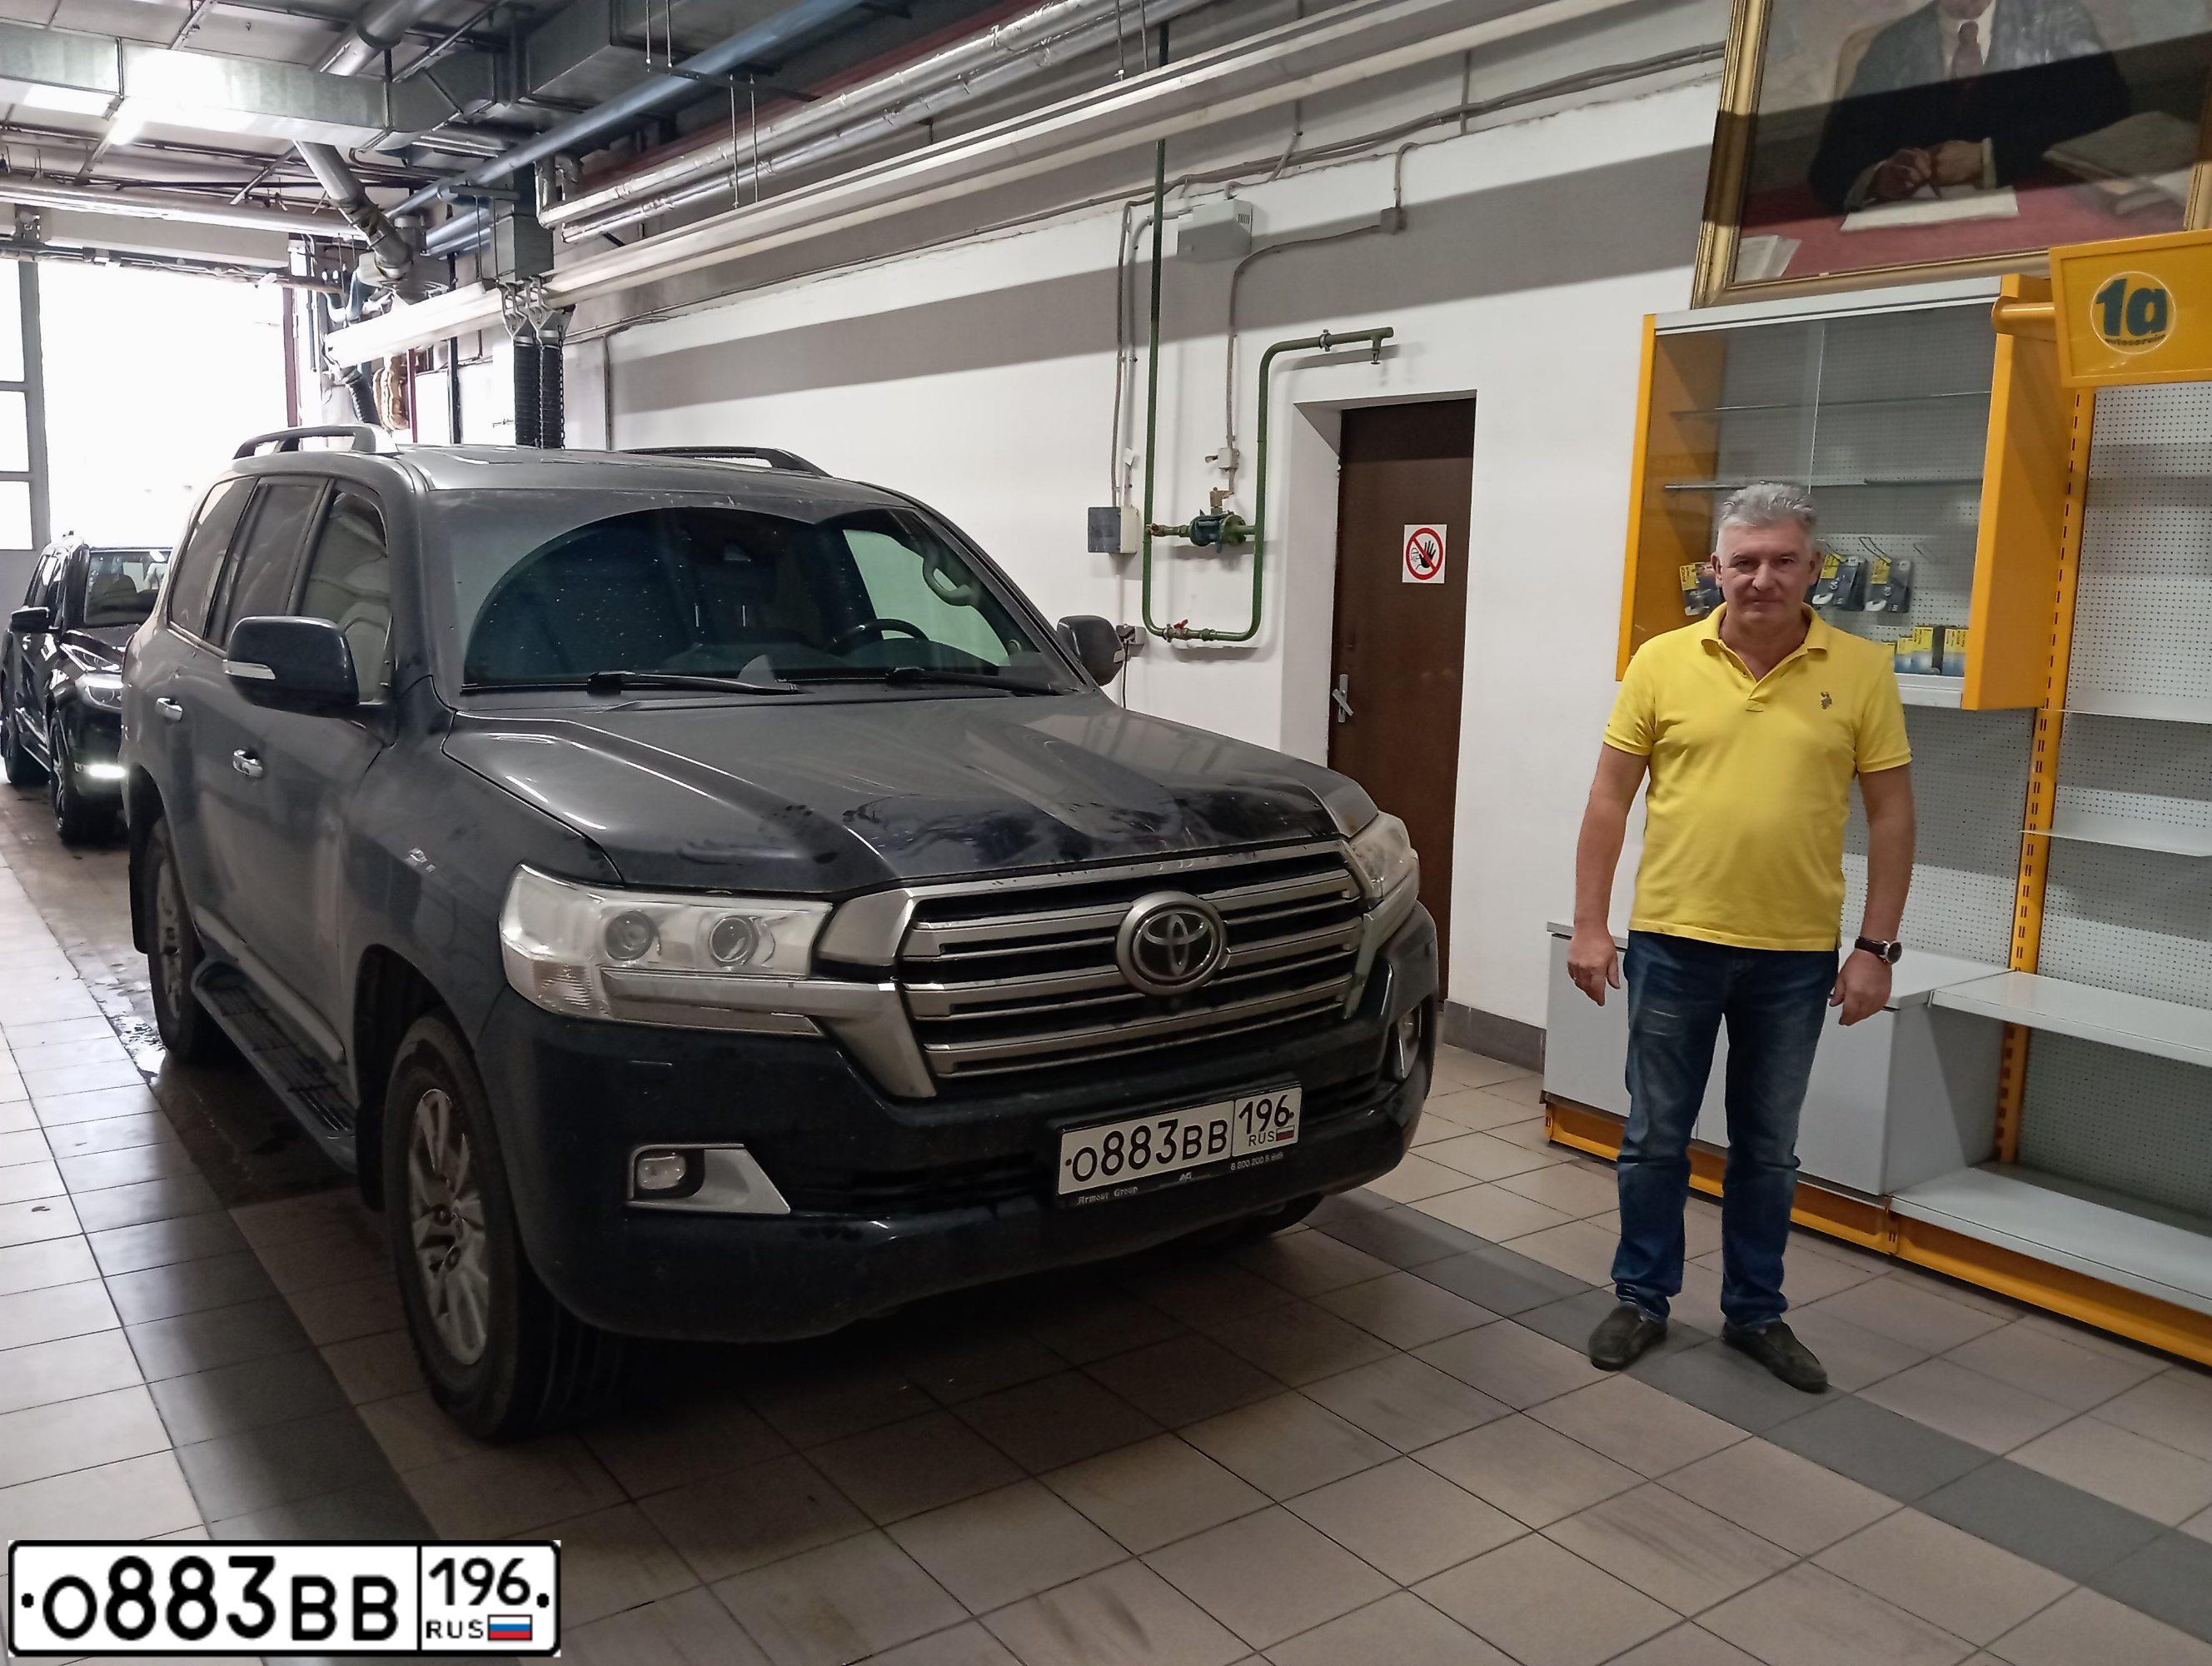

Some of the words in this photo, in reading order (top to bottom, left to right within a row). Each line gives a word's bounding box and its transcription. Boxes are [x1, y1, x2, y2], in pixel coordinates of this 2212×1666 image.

[2095, 278, 2169, 337] 1a
[1238, 1095, 1288, 1134] 196
[1248, 1131, 1275, 1146] RUS
[1113, 1186, 1138, 1197] Group
